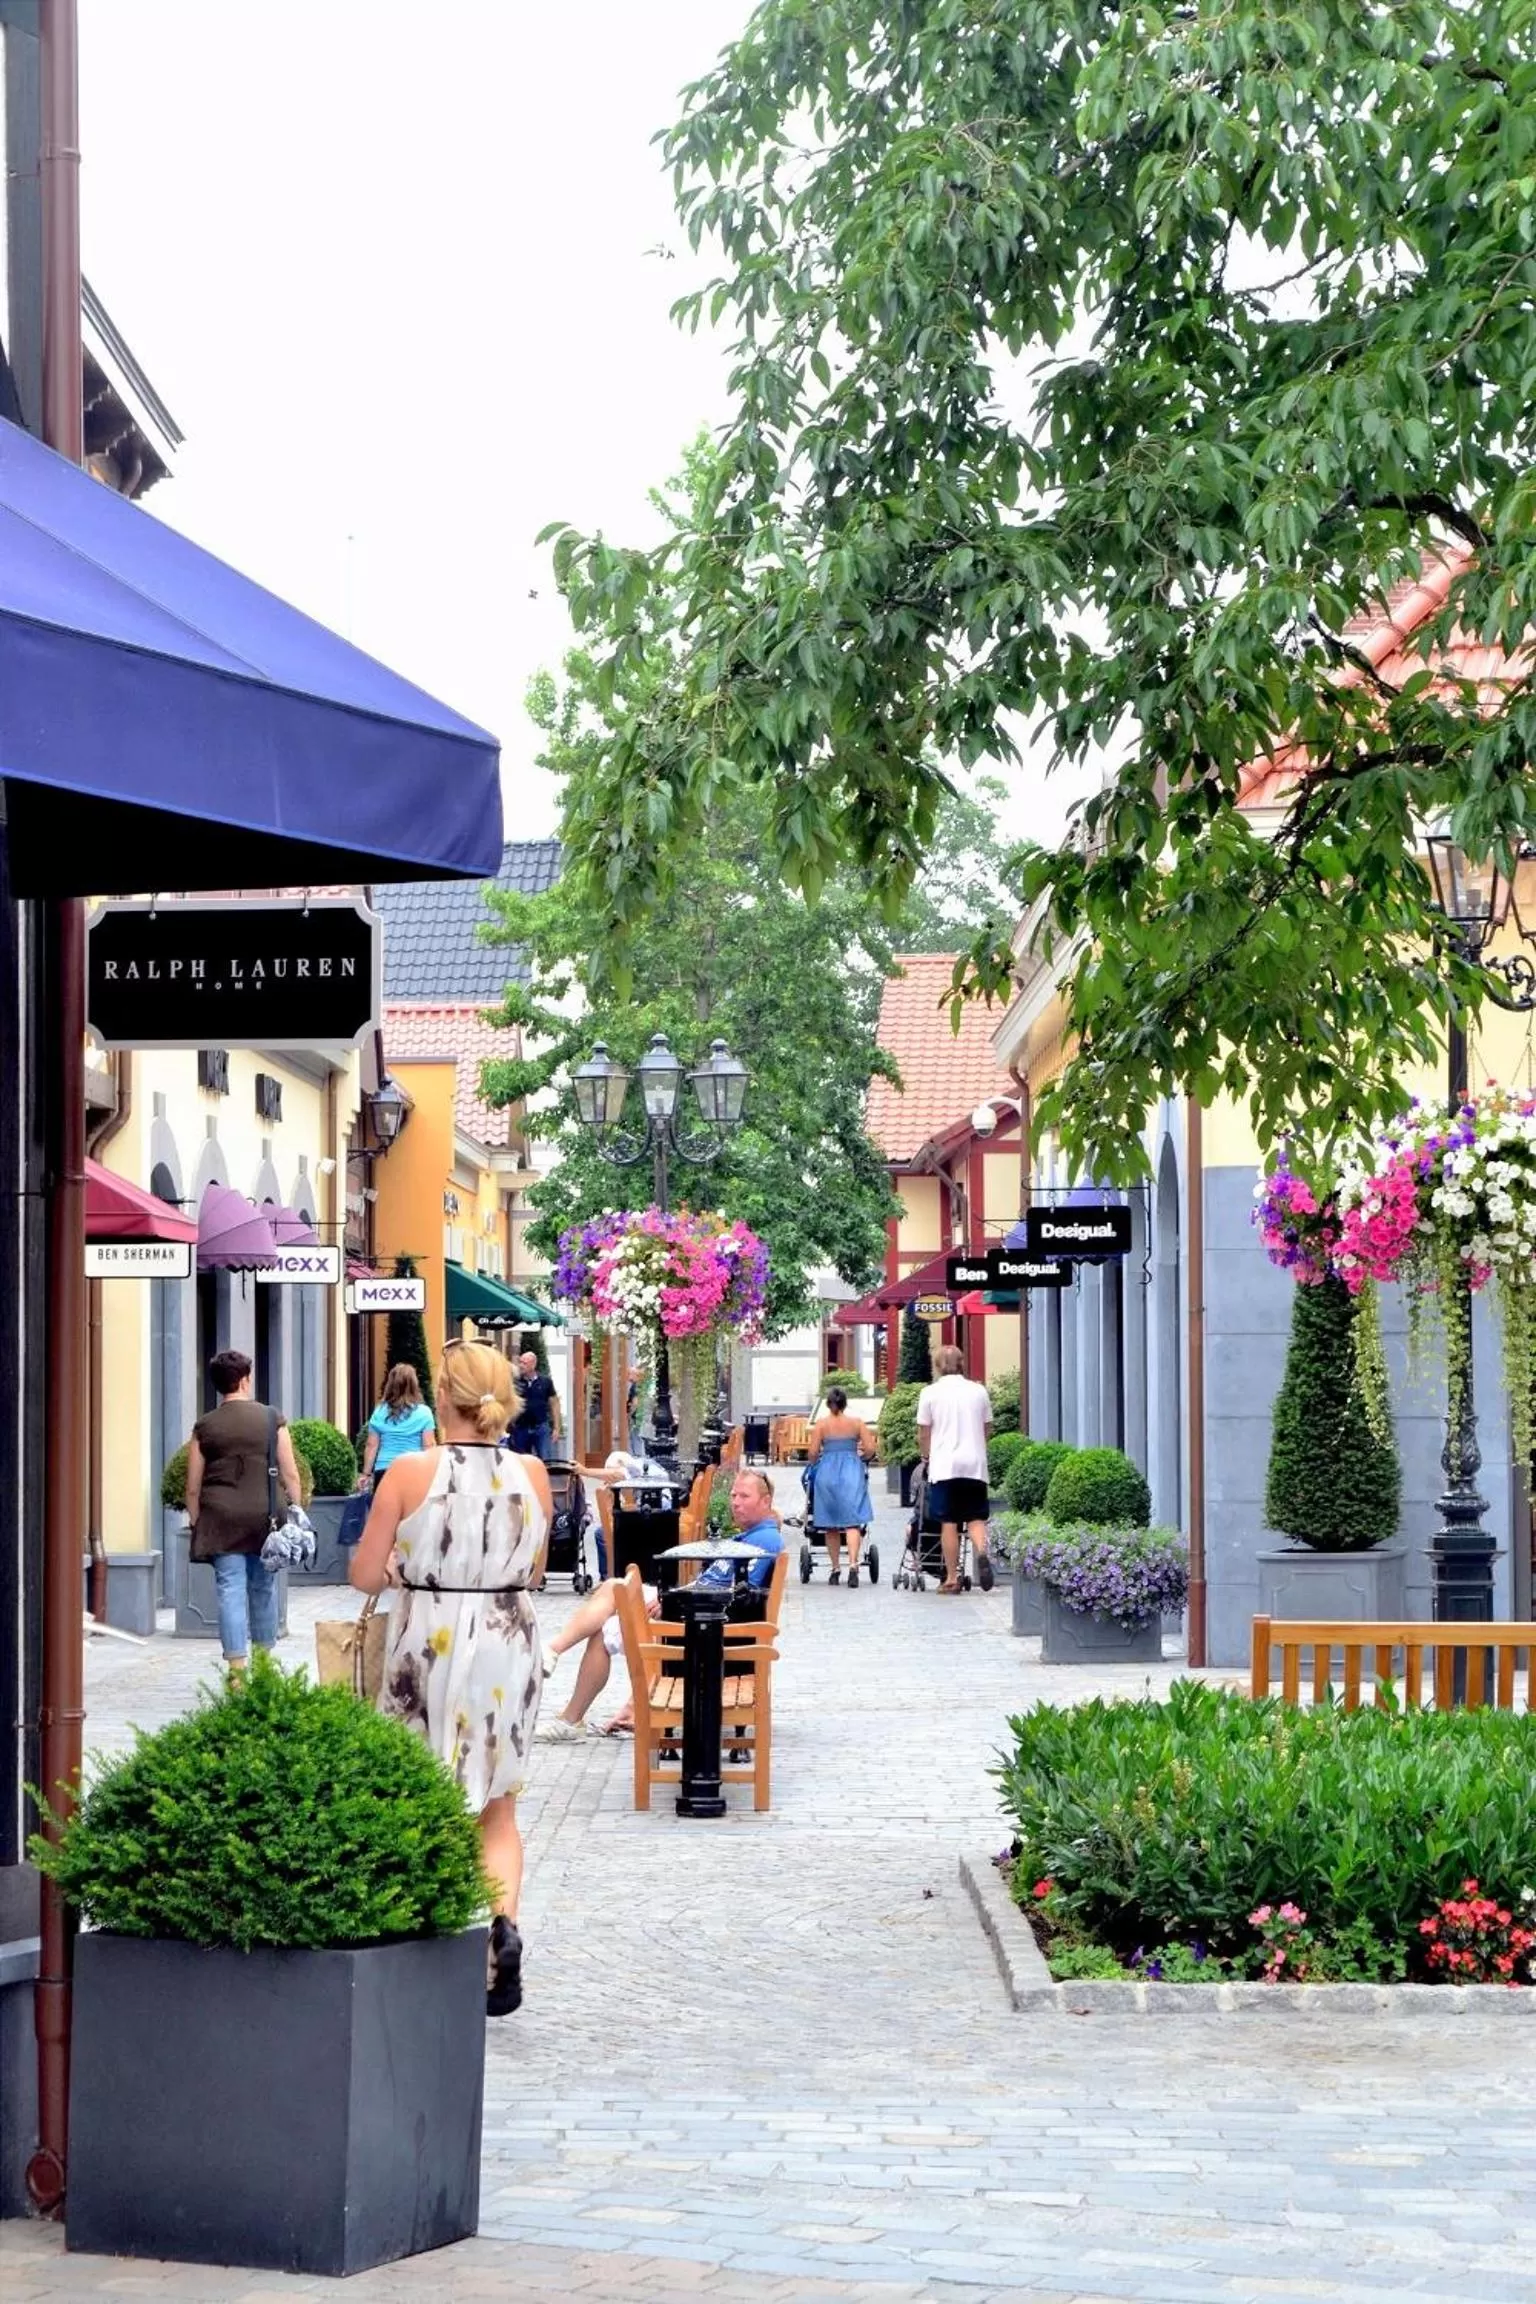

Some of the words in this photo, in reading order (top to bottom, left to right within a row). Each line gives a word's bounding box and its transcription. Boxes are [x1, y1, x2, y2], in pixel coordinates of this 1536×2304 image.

[104, 960, 206, 979] RALPH
[230, 958, 356, 978] LAUREN
[195, 981, 262, 990] HOME
[97, 1248, 118, 1261] BEN
[123, 1248, 176, 1261] SHERMAN
[914, 1303, 953, 1313] FOSSIL
